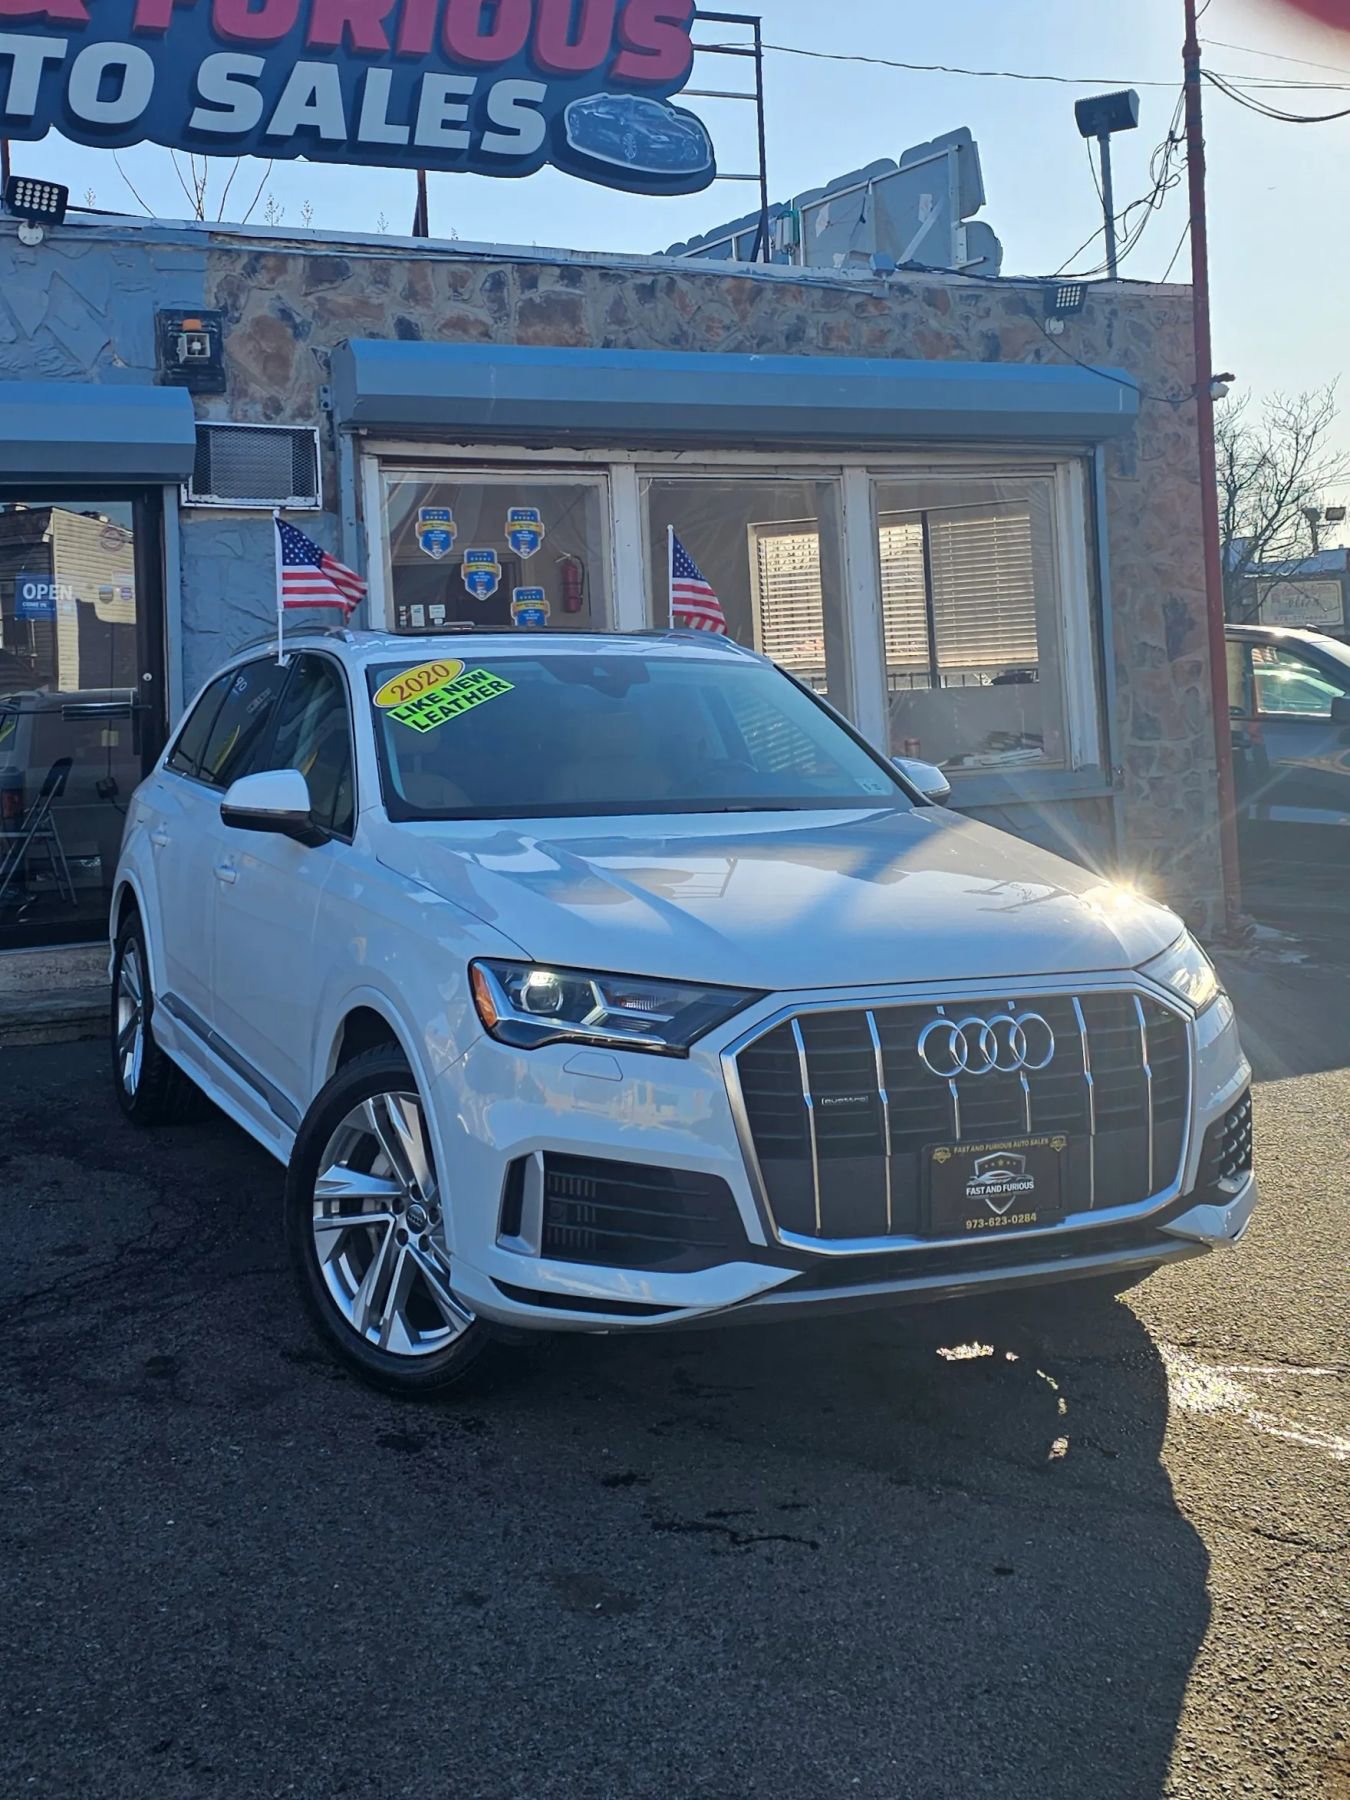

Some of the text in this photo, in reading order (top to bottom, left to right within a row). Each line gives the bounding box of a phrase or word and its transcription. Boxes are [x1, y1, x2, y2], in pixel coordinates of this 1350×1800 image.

[189, 52, 548, 155] SALES
[22, 583, 73, 600] OPEN
[390, 663, 450, 701] 2020
[392, 671, 489, 720] LIKE NEW
[411, 680, 509, 731] LEATHER
[954, 1137, 1049, 1154] FAST AND FURIOUS AUTO SALES
[966, 1186, 985, 1196] FAST
[985, 1184, 1002, 1194] AND
[1002, 1181, 1034, 1192] FURIOUS
[966, 1212, 1037, 1230] 973-623-0284
